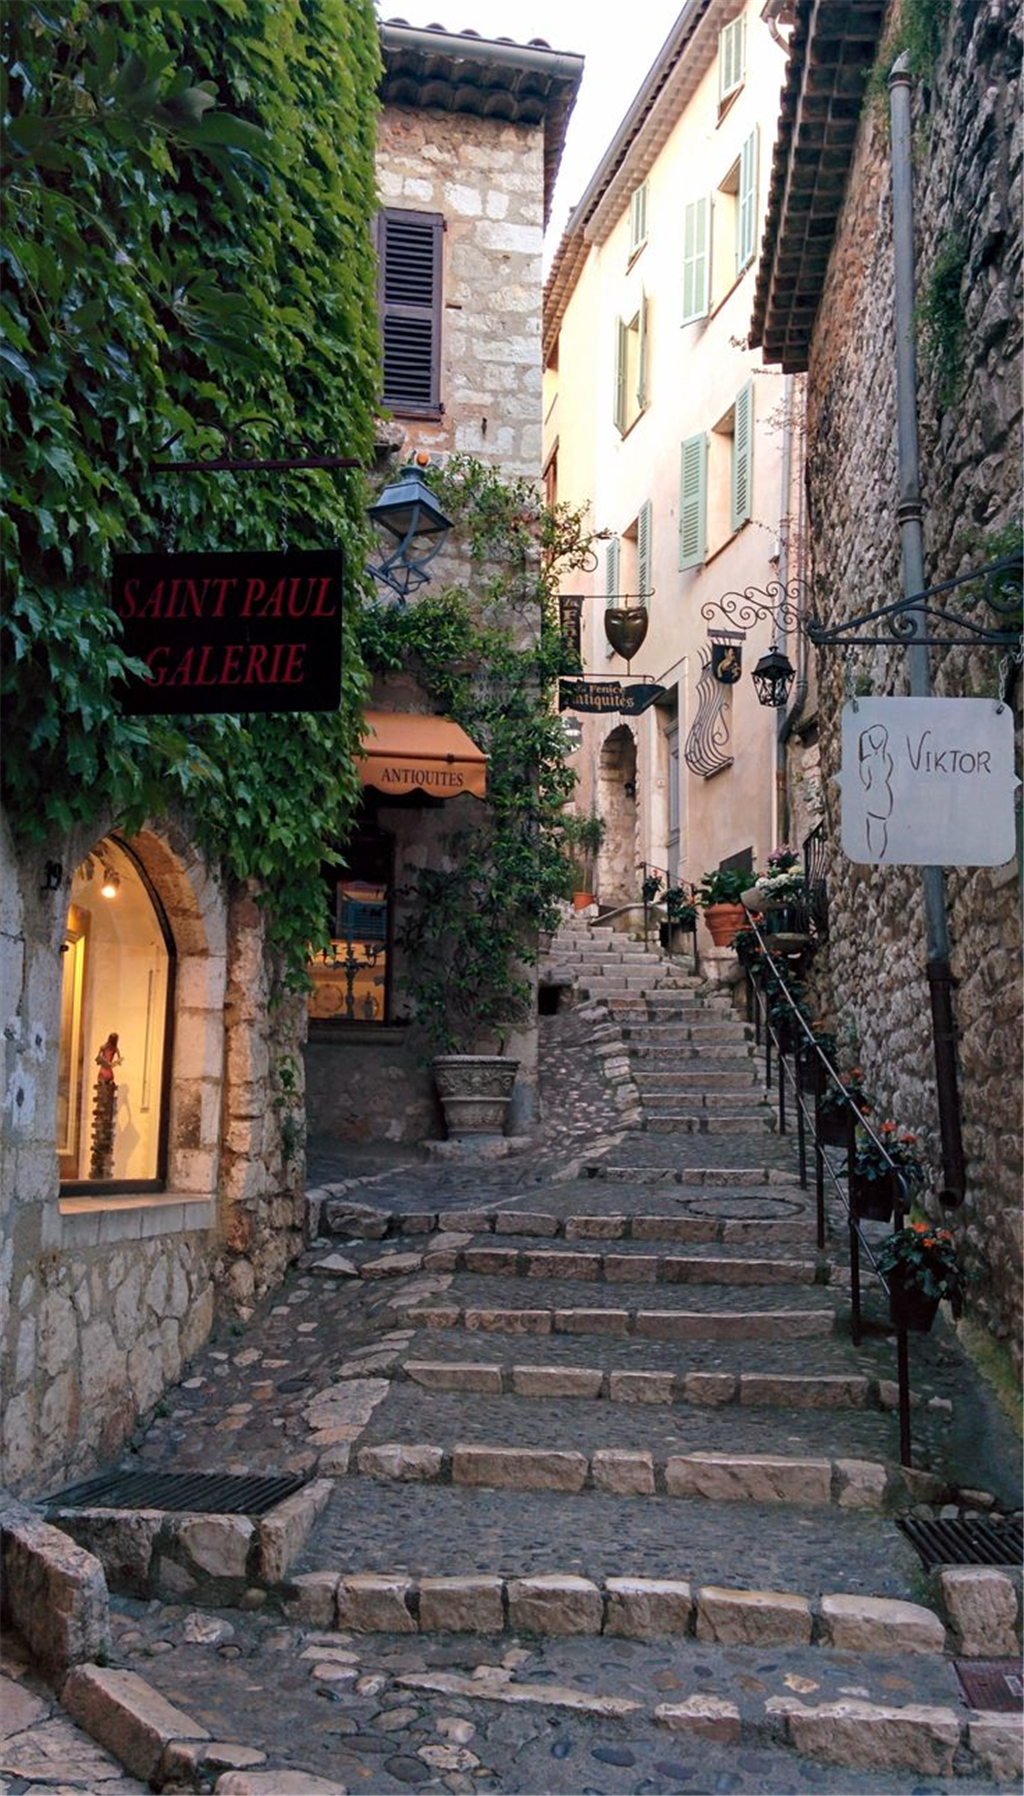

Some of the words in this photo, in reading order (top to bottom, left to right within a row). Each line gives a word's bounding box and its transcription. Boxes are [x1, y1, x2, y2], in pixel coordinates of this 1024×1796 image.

[118, 577, 236, 619] SAINT
[239, 577, 337, 617] PAUL
[143, 643, 307, 687] GALERIE
[566, 693, 637, 711] ntiquités
[905, 730, 992, 774] VIKTOR
[381, 768, 464, 787] ANTIQUITES
